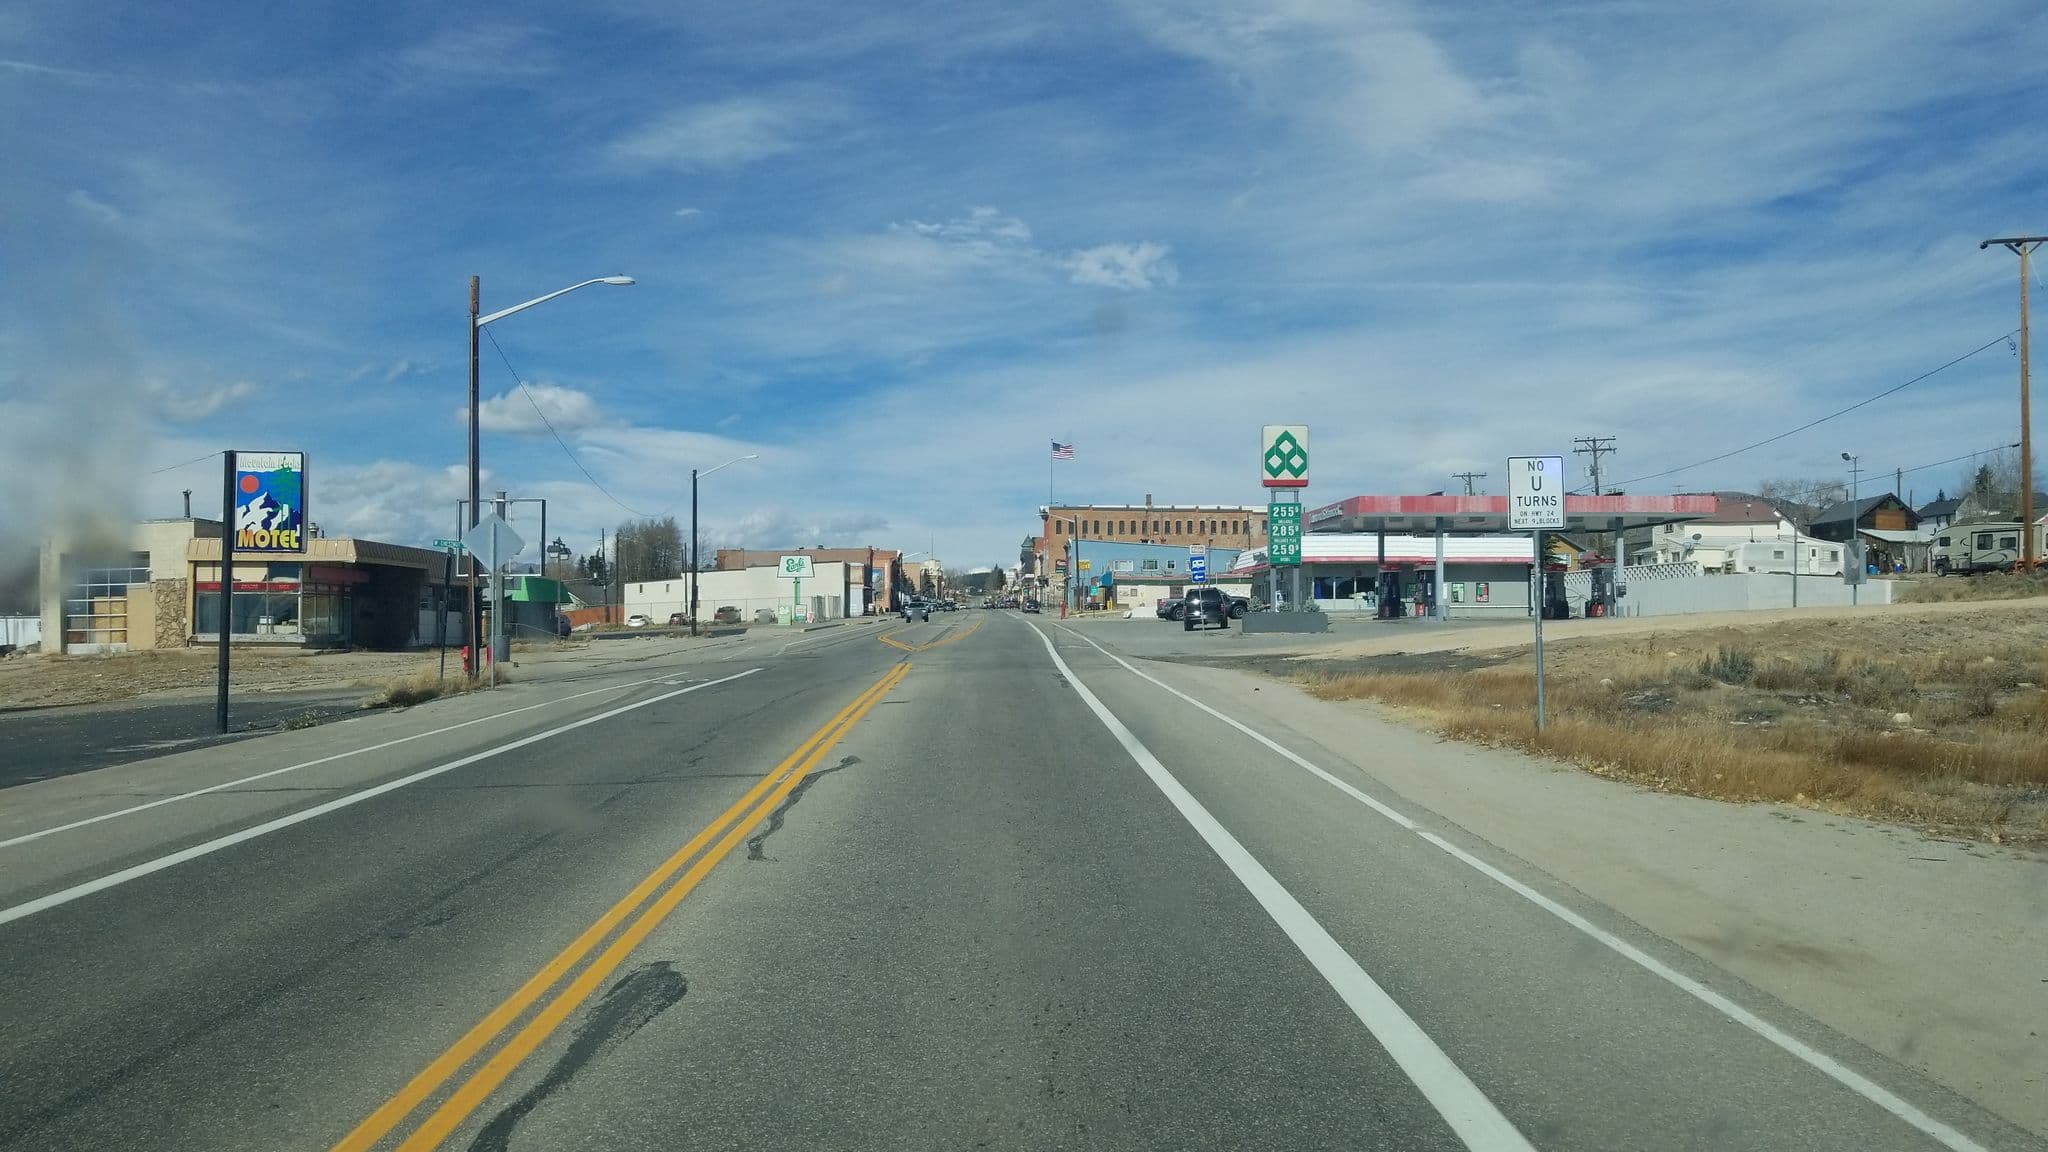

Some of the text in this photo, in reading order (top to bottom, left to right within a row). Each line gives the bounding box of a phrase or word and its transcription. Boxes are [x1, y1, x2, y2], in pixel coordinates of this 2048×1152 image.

[1527, 460, 1544, 472] NO
[1531, 475, 1542, 492] U
[1516, 495, 1557, 507] TURNS
[238, 529, 299, 548] MOTEL
